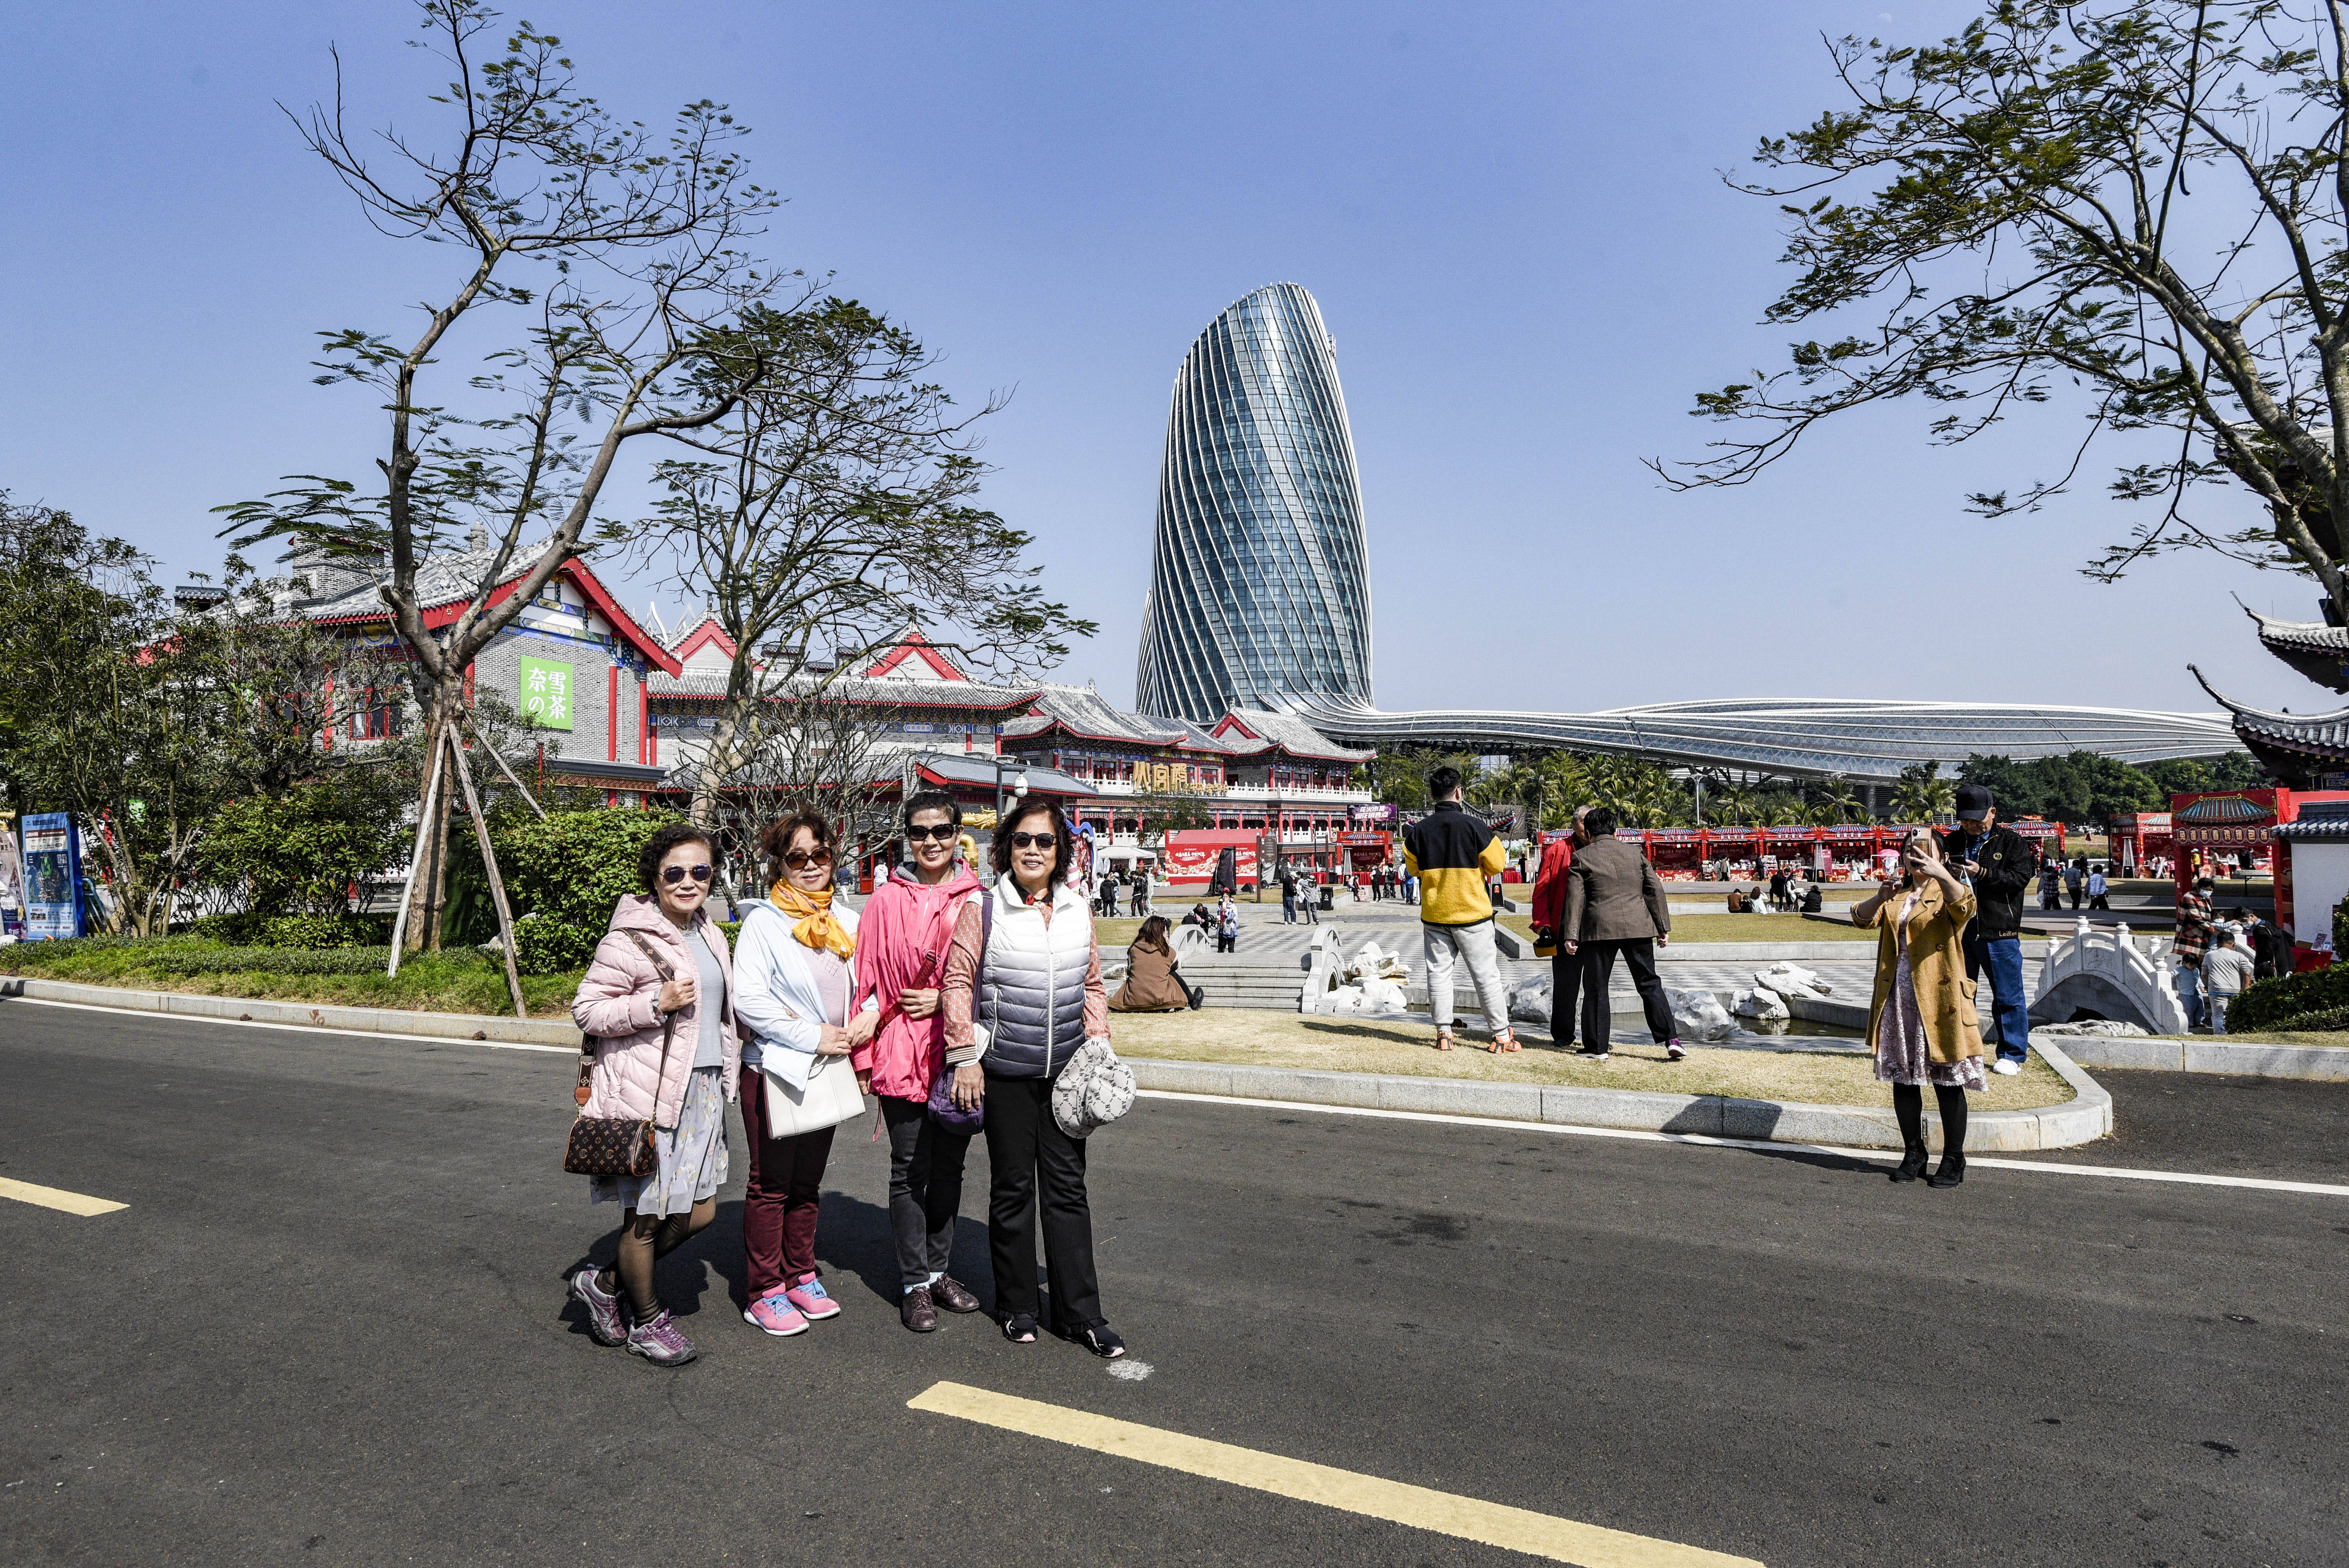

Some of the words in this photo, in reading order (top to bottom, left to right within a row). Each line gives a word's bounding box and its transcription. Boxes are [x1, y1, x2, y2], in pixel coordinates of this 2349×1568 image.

[528, 666, 567, 696] 奈雪
[1354, 811, 1389, 820] 烟花销售点
[1073, 1055, 1078, 1063] NY
[1125, 1071, 1132, 1079] NY
[1123, 1086, 1132, 1094] NY
[1063, 1093, 1068, 1102] NY
[1087, 1096, 1093, 1104] NY
[1094, 1092, 1101, 1100] NY
[1055, 1107, 1060, 1115] NY
[1105, 1104, 1111, 1112] NY
